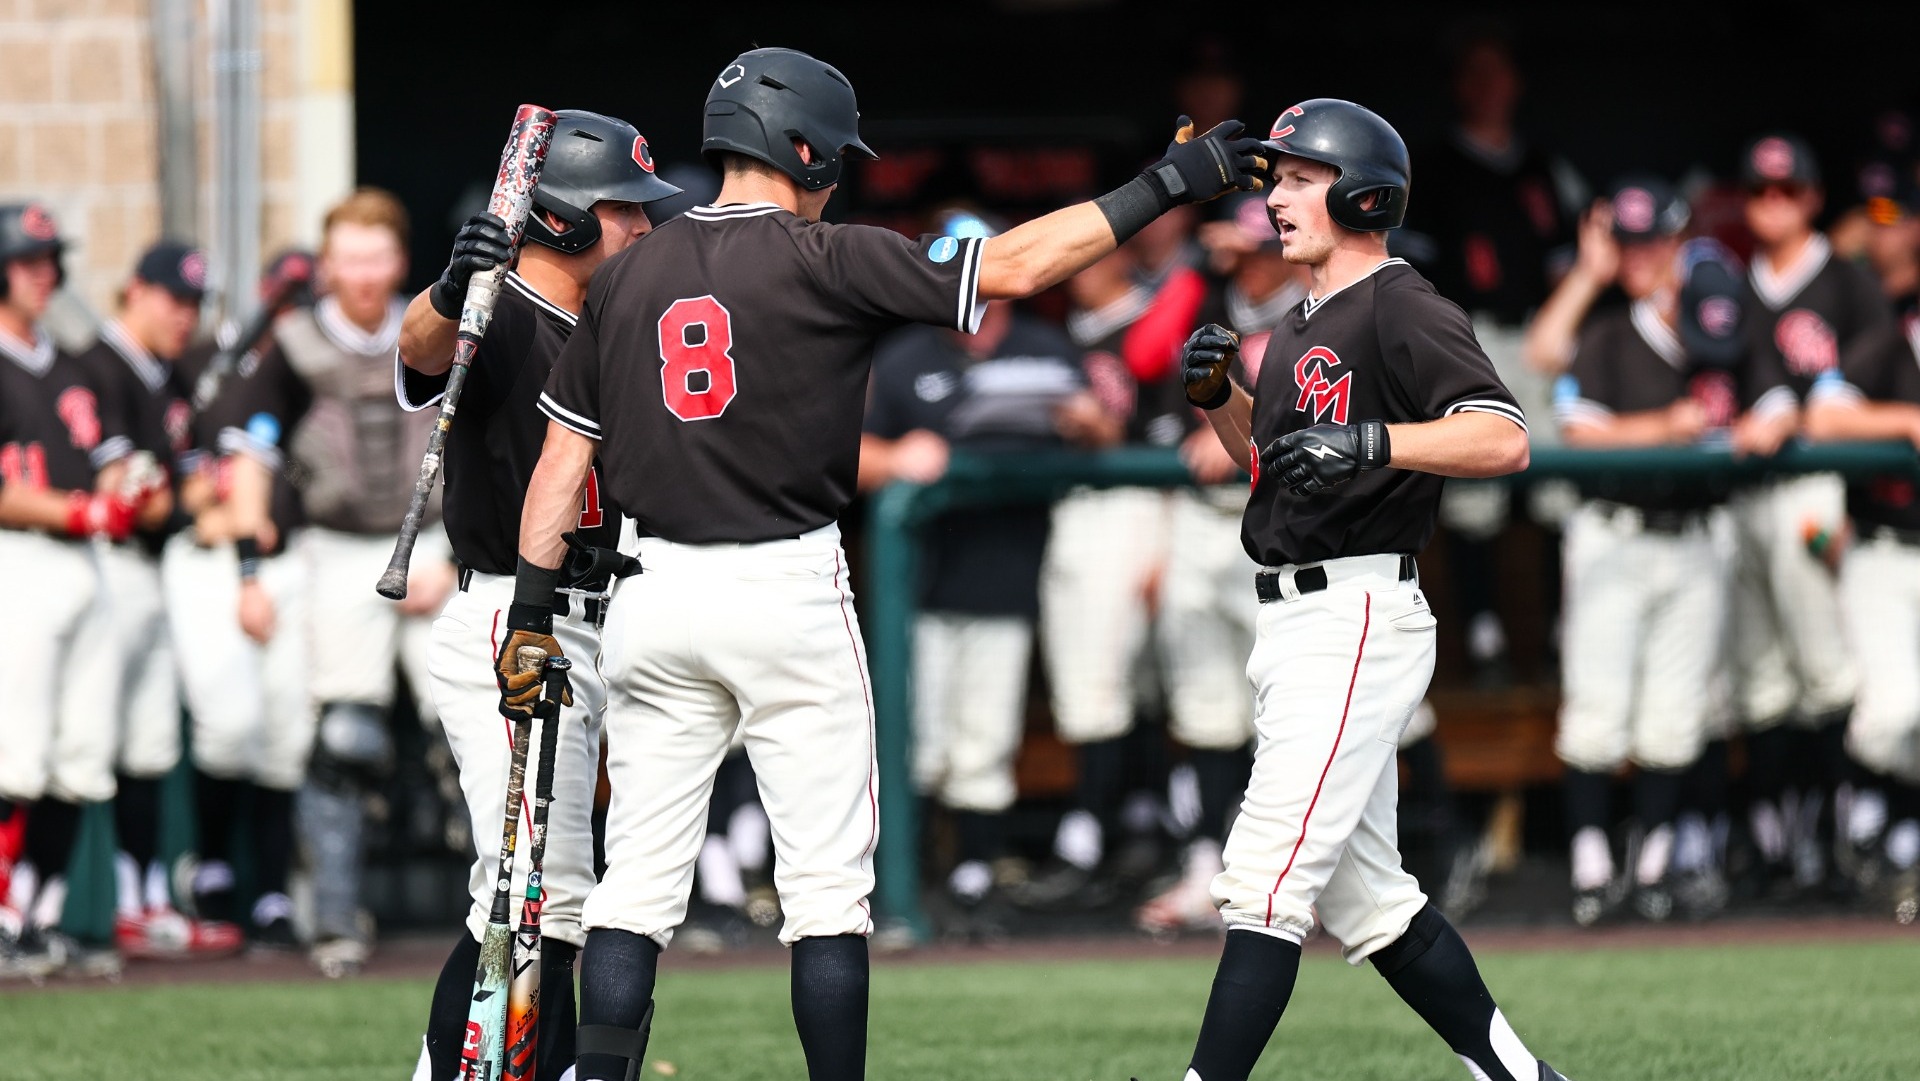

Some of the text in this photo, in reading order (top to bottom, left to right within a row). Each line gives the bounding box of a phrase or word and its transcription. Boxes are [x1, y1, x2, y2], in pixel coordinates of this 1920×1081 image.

[1269, 105, 1305, 140] C
[631, 134, 655, 174] C
[658, 295, 737, 422] 8
